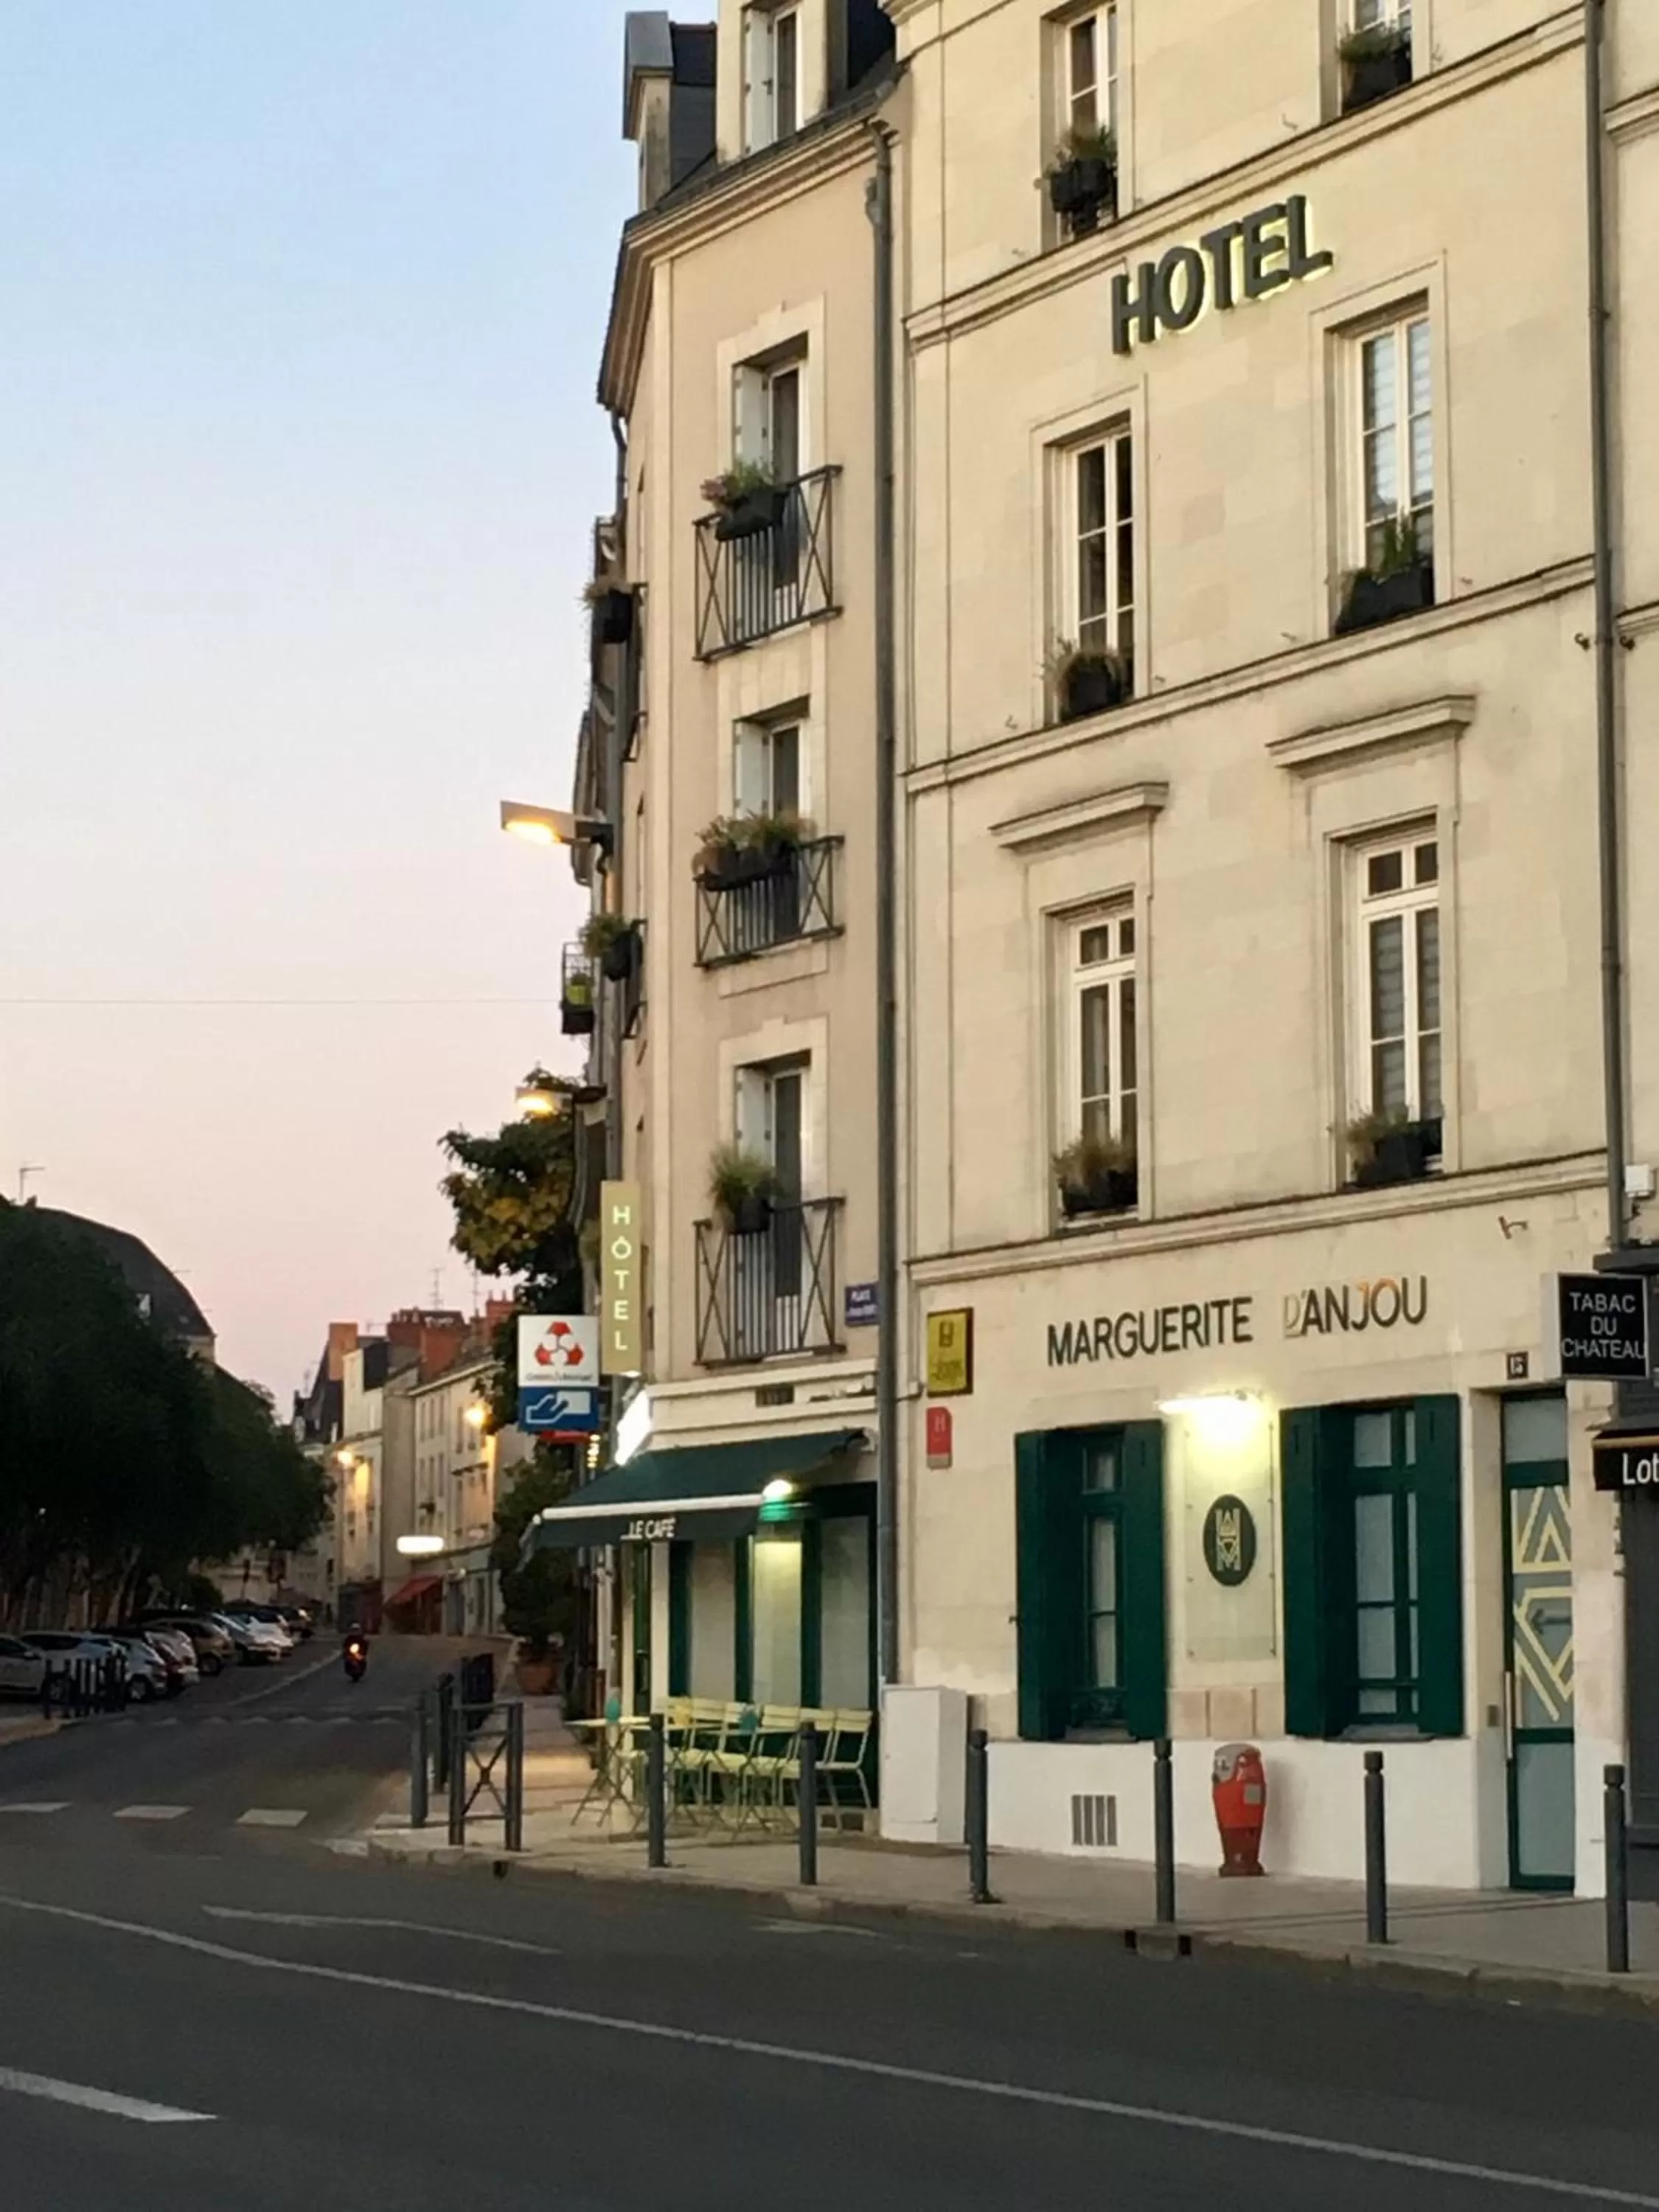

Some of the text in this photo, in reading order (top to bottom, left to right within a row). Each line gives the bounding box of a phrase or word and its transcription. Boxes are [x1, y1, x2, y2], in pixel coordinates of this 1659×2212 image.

[1112, 195, 1333, 355] HOTEL
[1569, 1292, 1636, 1313] TABAC
[1047, 1296, 1253, 1367] MARGUERITE
[1590, 1315, 1617, 1336] DU
[1561, 1338, 1645, 1359] CHATEAU
[625, 1520, 644, 1540] LE
